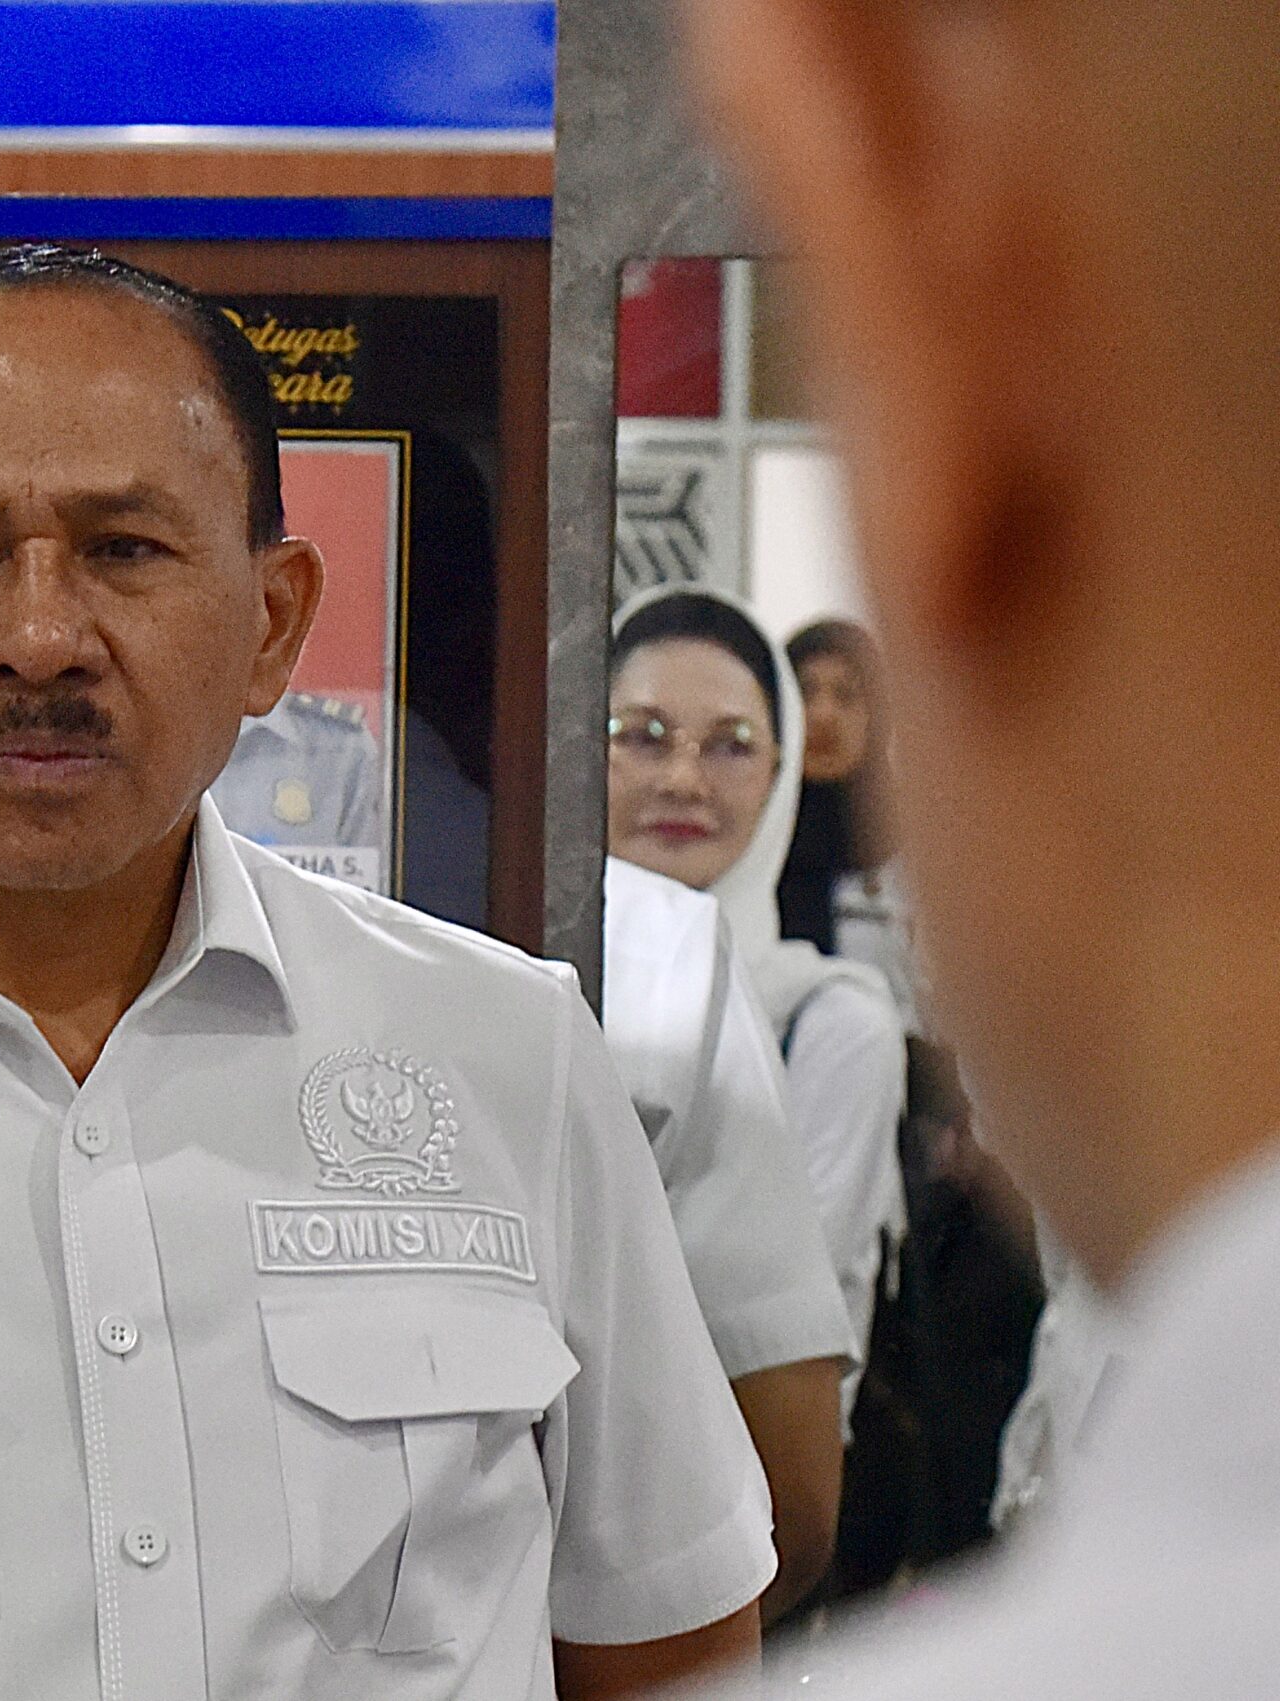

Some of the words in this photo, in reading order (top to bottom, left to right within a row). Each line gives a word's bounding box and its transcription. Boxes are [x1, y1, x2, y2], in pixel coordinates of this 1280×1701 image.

[220, 307, 360, 368] etugas
[269, 372, 354, 403] cara
[282, 854, 337, 879] THA
[264, 1209, 440, 1262] KOMISI
[453, 1212, 521, 1266] XIII
